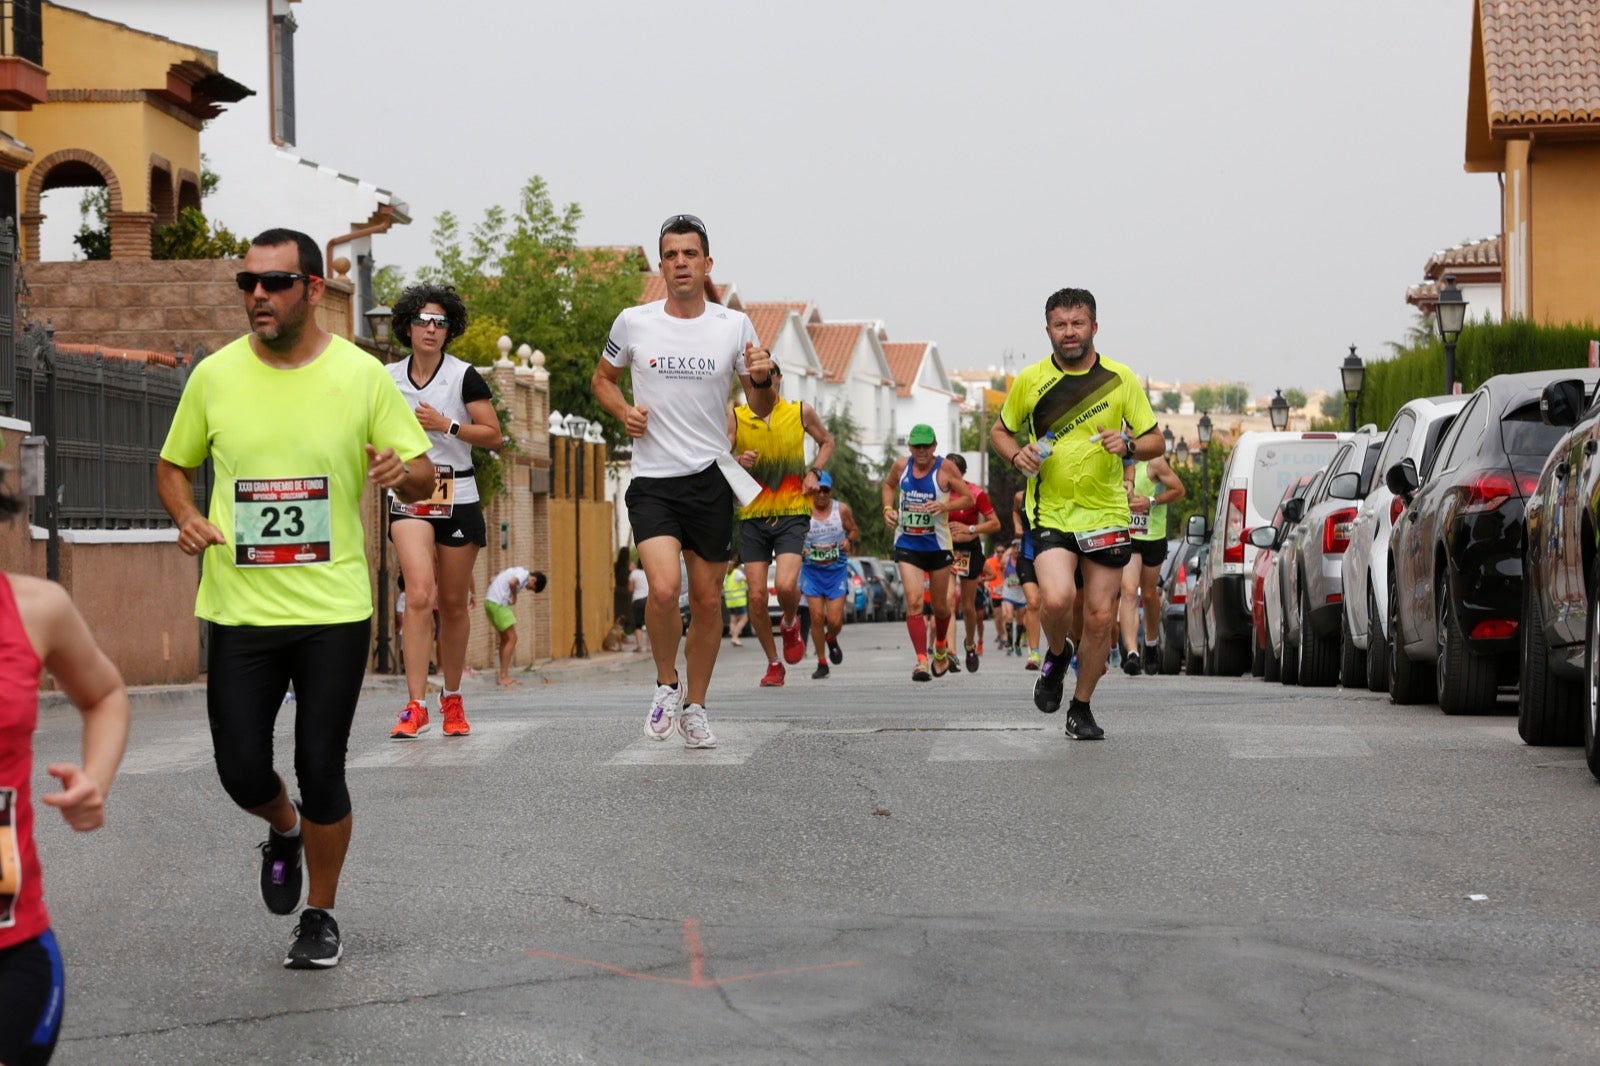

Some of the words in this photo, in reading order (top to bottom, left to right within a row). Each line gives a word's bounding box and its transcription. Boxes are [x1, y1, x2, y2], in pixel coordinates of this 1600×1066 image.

[658, 357, 715, 371] TEXCON
[1074, 401, 1109, 426] ALHENDÍN
[253, 481, 270, 492] GRAN
[270, 480, 294, 491] PREMIO
[294, 480, 303, 490] DE
[303, 479, 324, 490] FONDO
[260, 505, 305, 538] 23
[907, 513, 931, 525] 179
